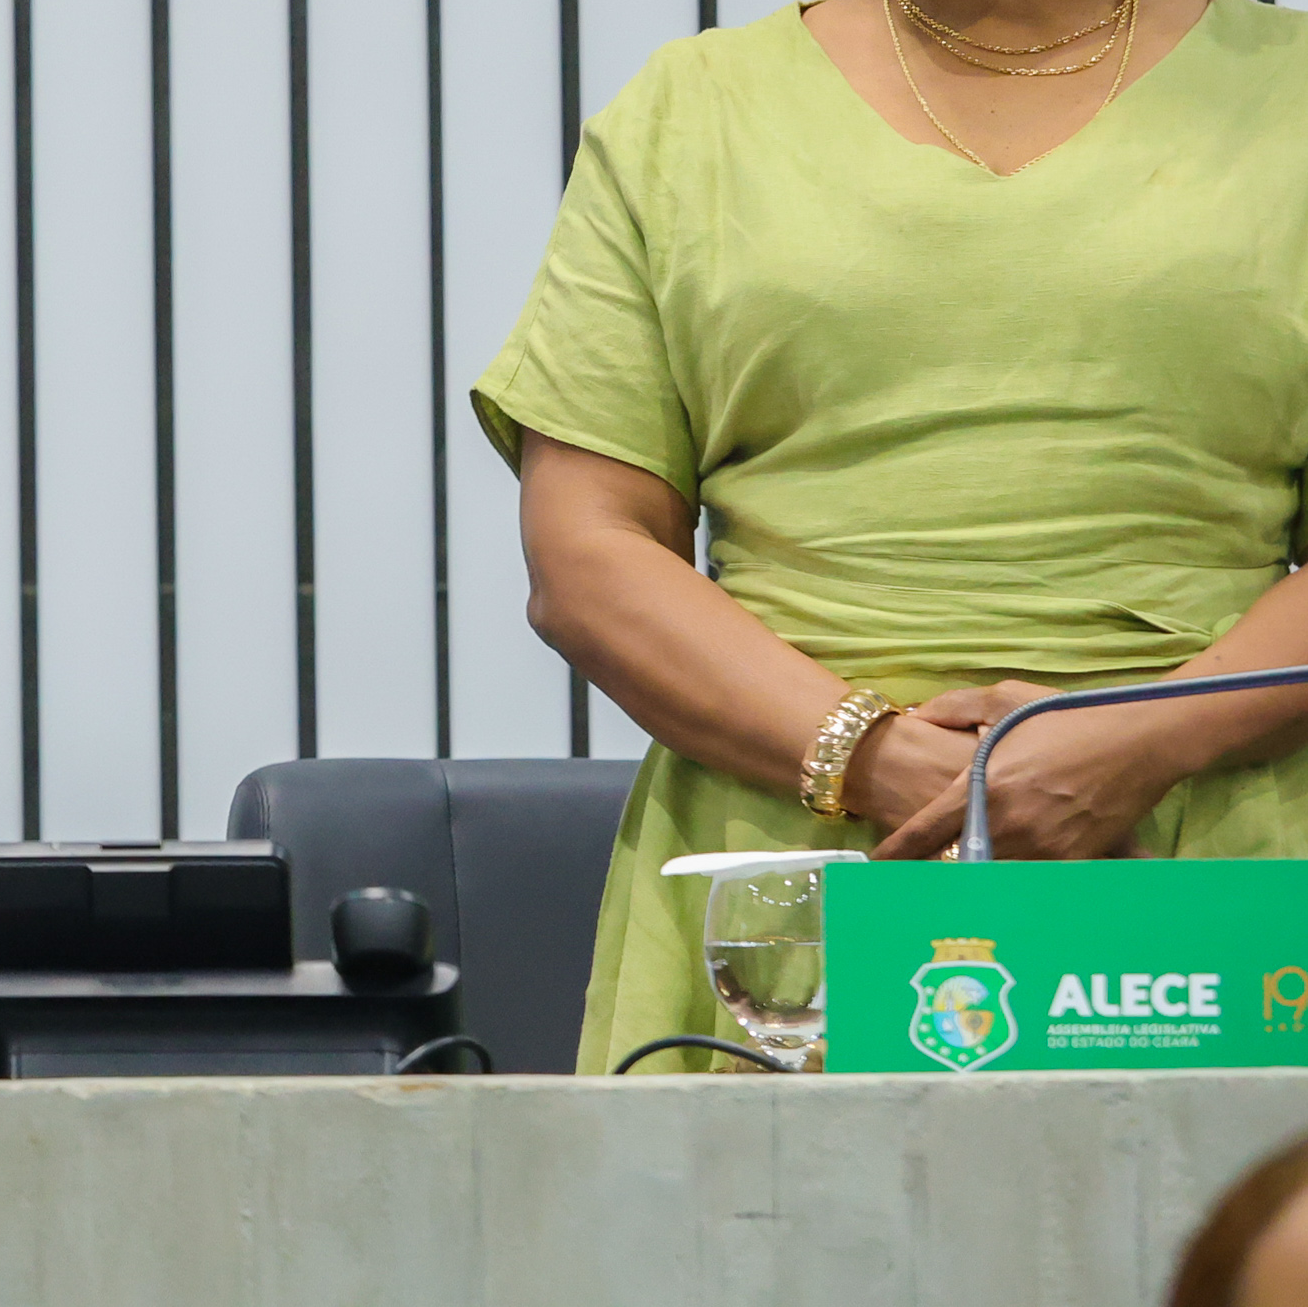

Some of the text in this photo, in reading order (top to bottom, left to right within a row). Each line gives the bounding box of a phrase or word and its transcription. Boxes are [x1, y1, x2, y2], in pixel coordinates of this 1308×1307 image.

[1048, 972, 1221, 1017] ALECE
[1047, 1023, 1221, 1036] ASSEMBLEIA LEGISLATIVA
[1048, 1036, 1068, 1049] DO
[1071, 1036, 1126, 1049] ESTADO
[1129, 1036, 1150, 1049] DO
